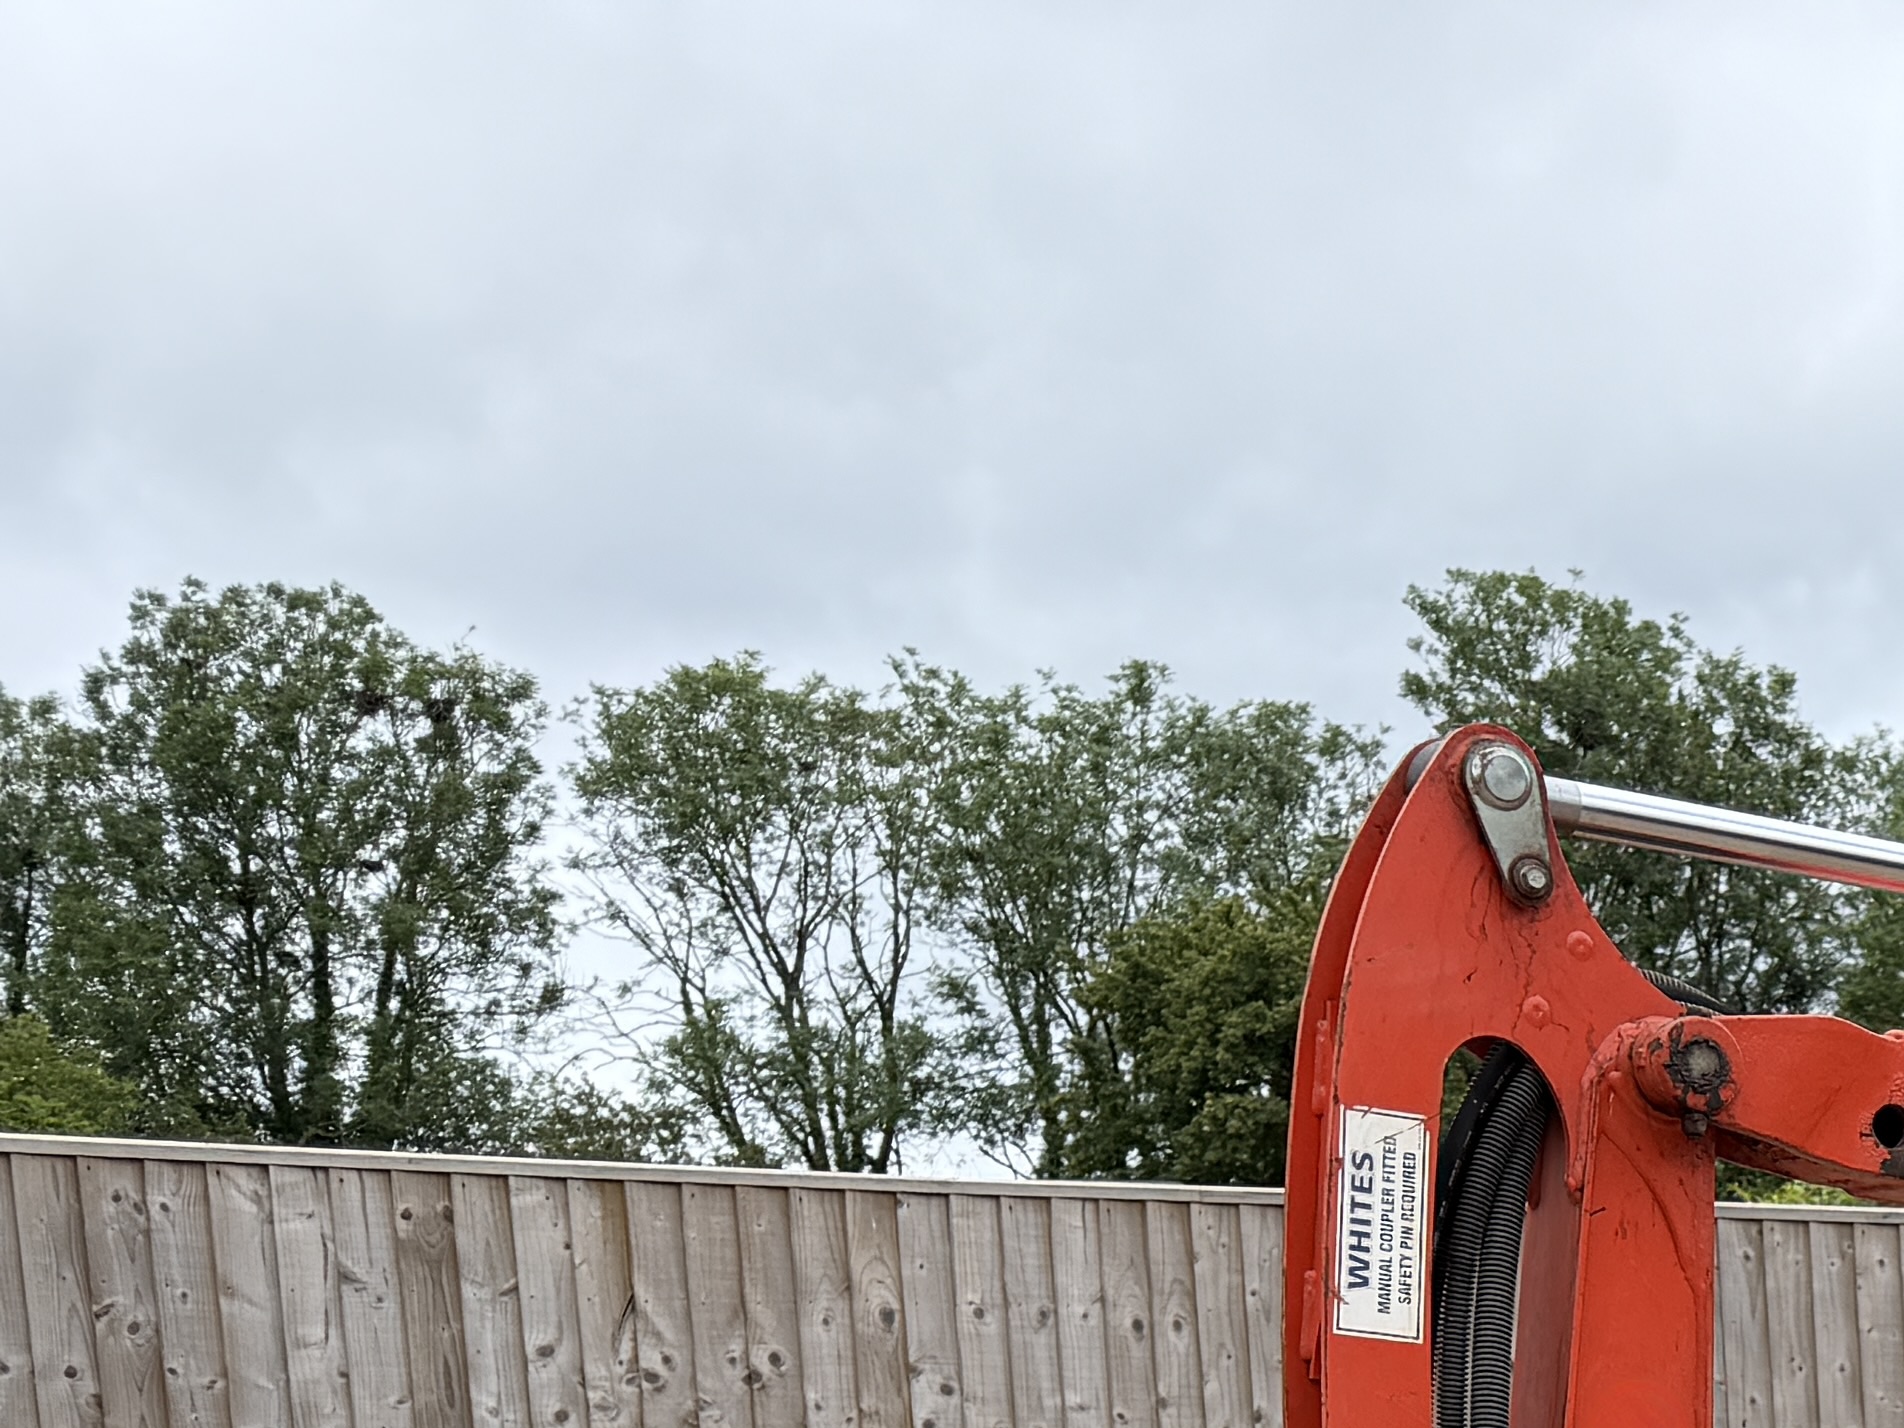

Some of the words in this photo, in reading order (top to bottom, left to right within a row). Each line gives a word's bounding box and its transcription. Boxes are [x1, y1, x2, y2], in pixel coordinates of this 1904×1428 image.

[1382, 1135, 1398, 1183] FITTED
[1401, 1152, 1417, 1222] REQUIRED
[1347, 1149, 1374, 1290] WHITES
[1378, 1185, 1395, 1253] COUPLER
[1400, 1224, 1415, 1250] PIN
[1378, 1256, 1393, 1315] MANUAL
[1397, 1255, 1413, 1305] SAFETY
